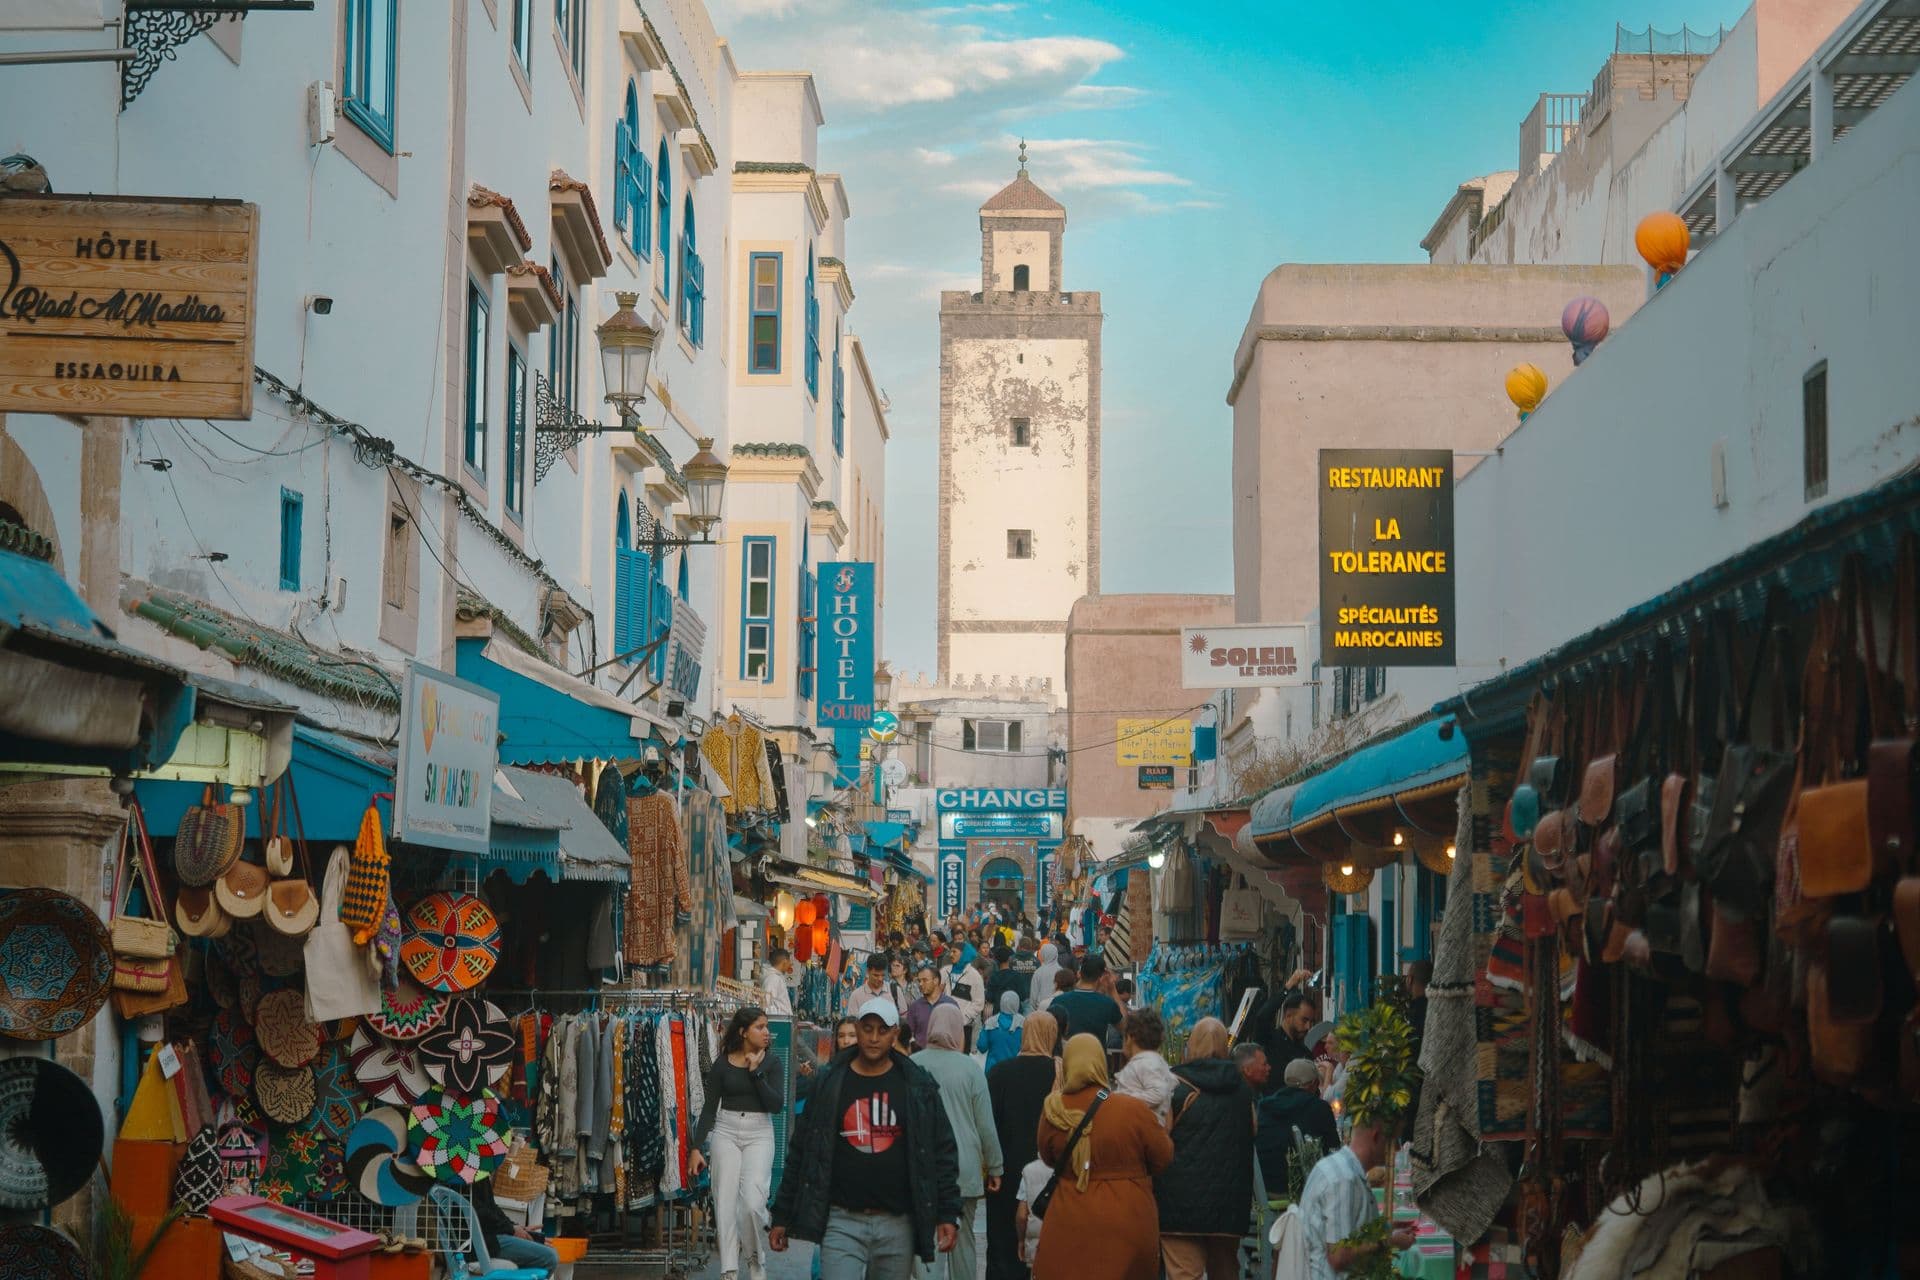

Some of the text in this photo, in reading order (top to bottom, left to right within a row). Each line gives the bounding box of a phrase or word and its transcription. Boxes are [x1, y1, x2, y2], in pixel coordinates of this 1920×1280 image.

[76, 231, 161, 261] HÔTEL
[11, 286, 225, 328] Riad Al Madina
[55, 362, 181, 382] ESSAOUIRA
[1329, 466, 1444, 489] RESTAURANT
[1375, 517, 1401, 540] LA
[1330, 550, 1446, 574] TOLERANCE
[1338, 603, 1439, 625] SPÉCIALITÉS
[832, 595, 859, 700] HOTEL
[1334, 630, 1443, 648] MAROCAINES
[1210, 646, 1297, 667] SOLEIL
[1239, 665, 1298, 677] LE SHOP
[939, 790, 1065, 808] CHANGE
